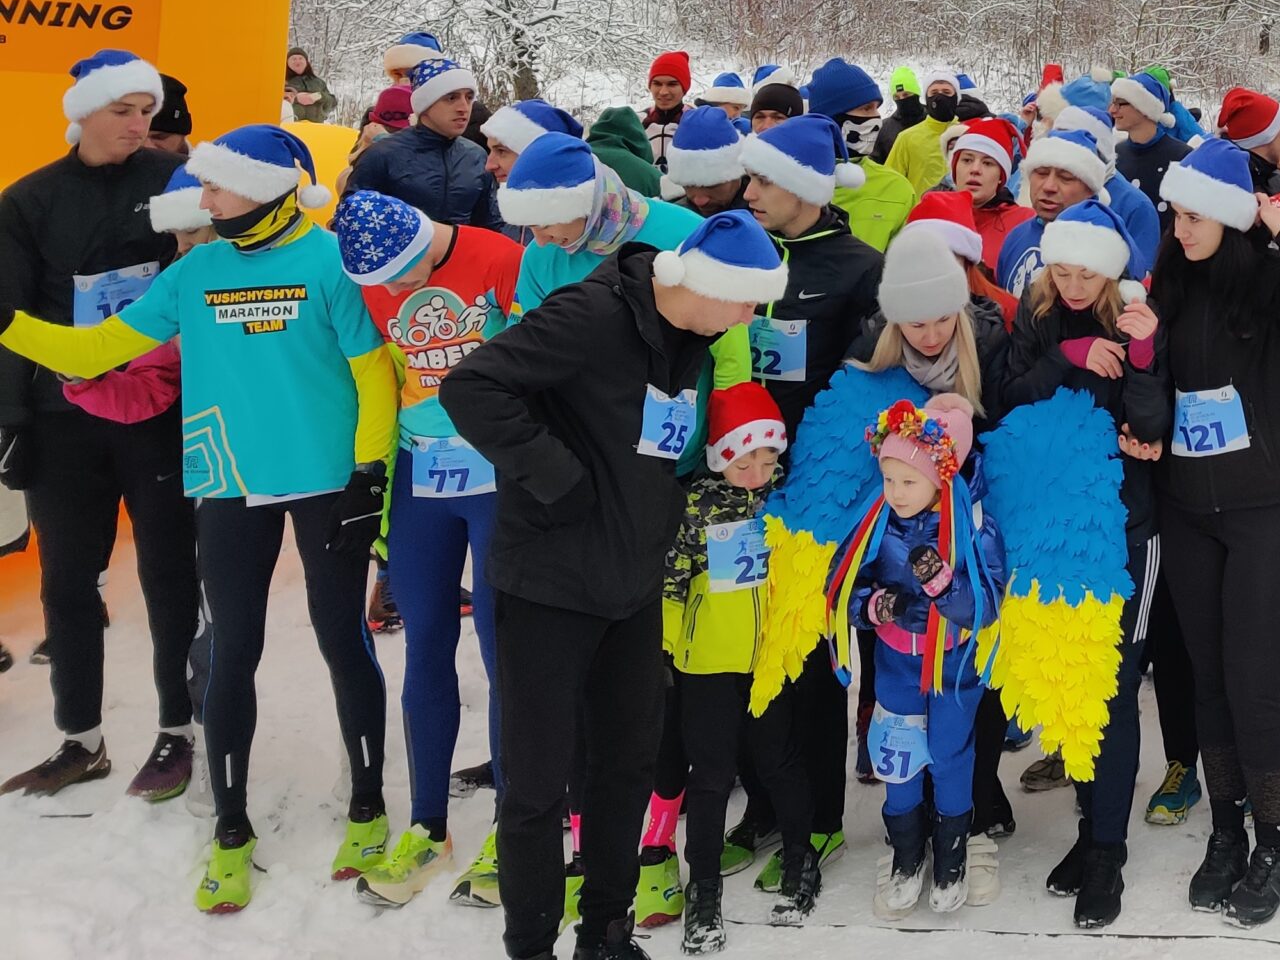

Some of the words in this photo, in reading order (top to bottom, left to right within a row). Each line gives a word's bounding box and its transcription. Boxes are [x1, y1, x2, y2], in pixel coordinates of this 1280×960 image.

[204, 287, 306, 305] YUSHCHYSHYN
[218, 305, 293, 319] MARATHON
[246, 320, 284, 334] TEAM
[657, 422, 688, 454] 25
[1179, 421, 1226, 452] 121
[428, 468, 470, 493] 77
[734, 551, 771, 585] 23
[876, 746, 912, 779] 31
